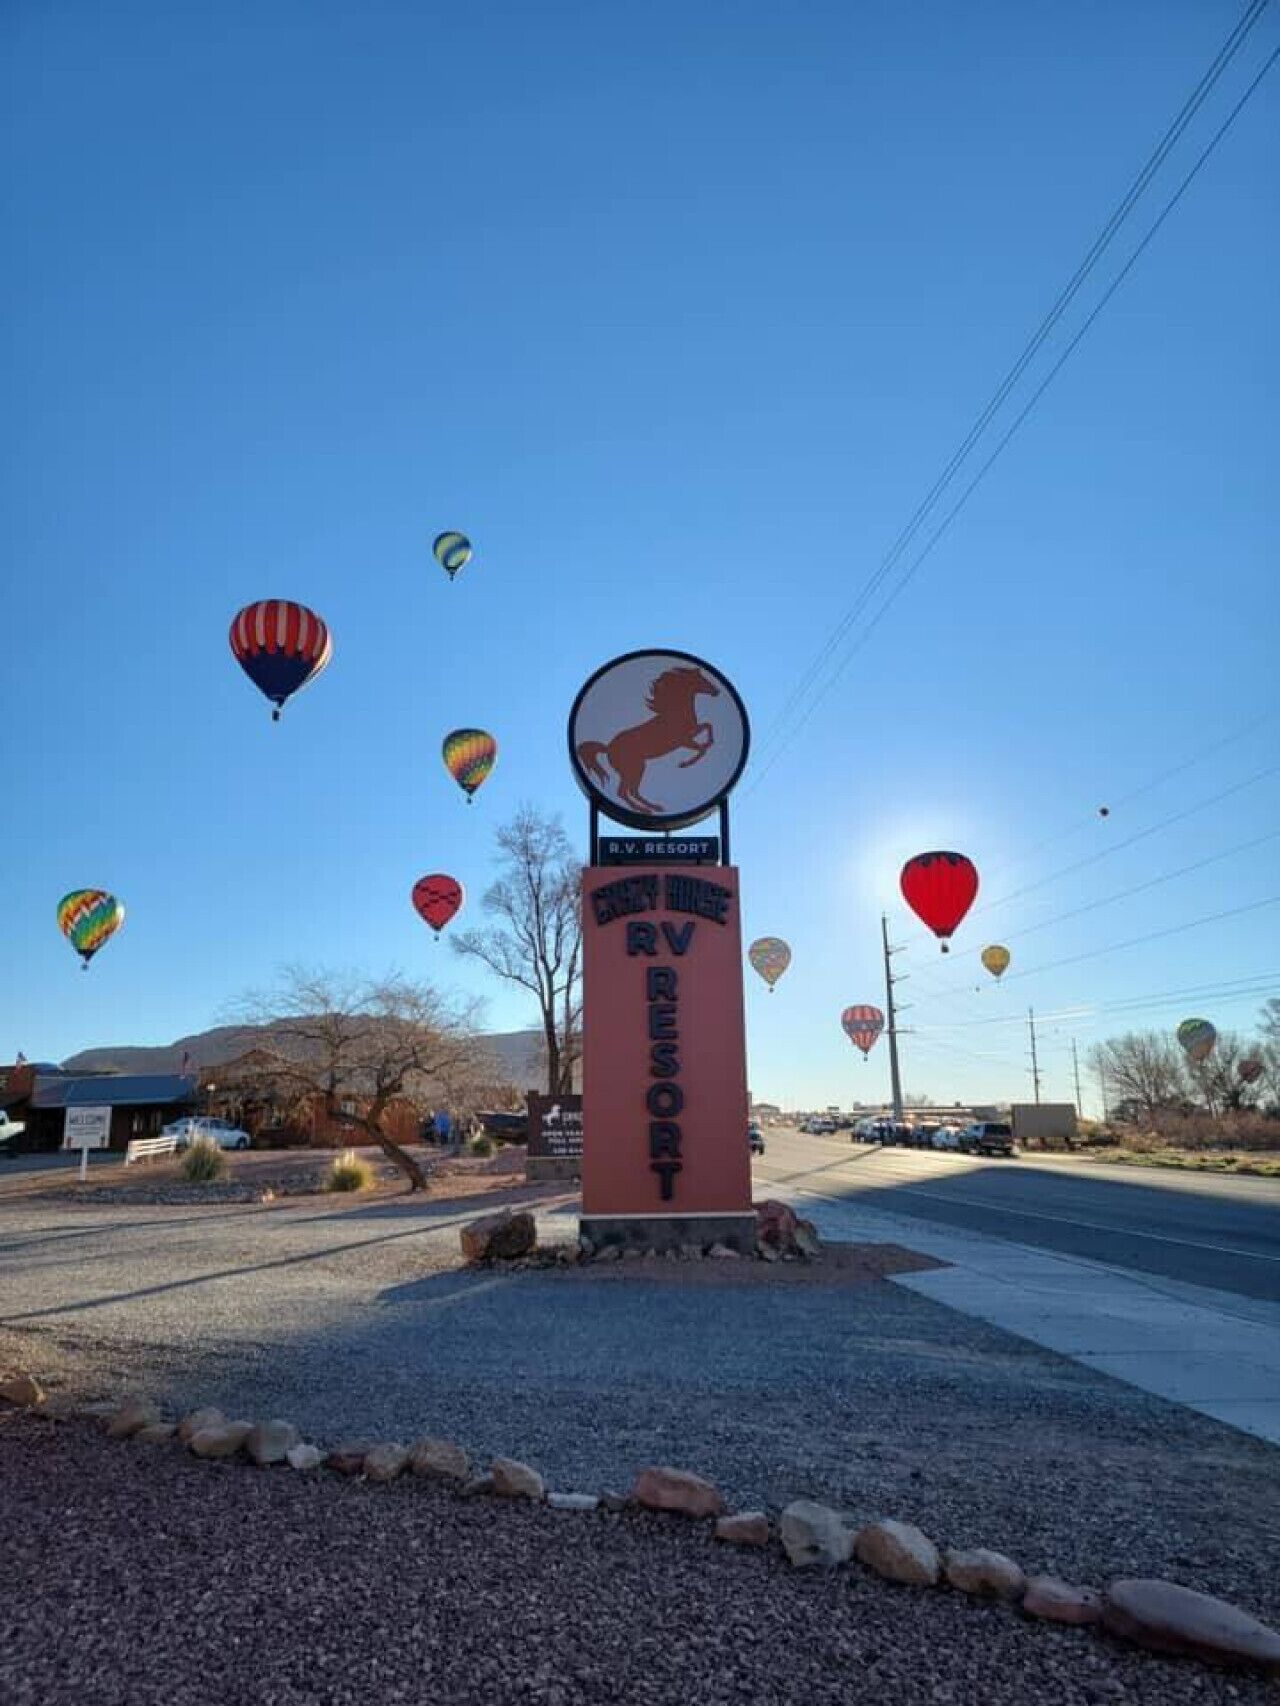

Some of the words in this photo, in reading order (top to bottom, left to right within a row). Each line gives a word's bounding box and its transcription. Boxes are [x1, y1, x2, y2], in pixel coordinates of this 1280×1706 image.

[609, 841, 639, 854] R.V.
[644, 841, 709, 854] RESORT
[626, 921, 695, 957] RV
[646, 966, 684, 1201] RESORT
